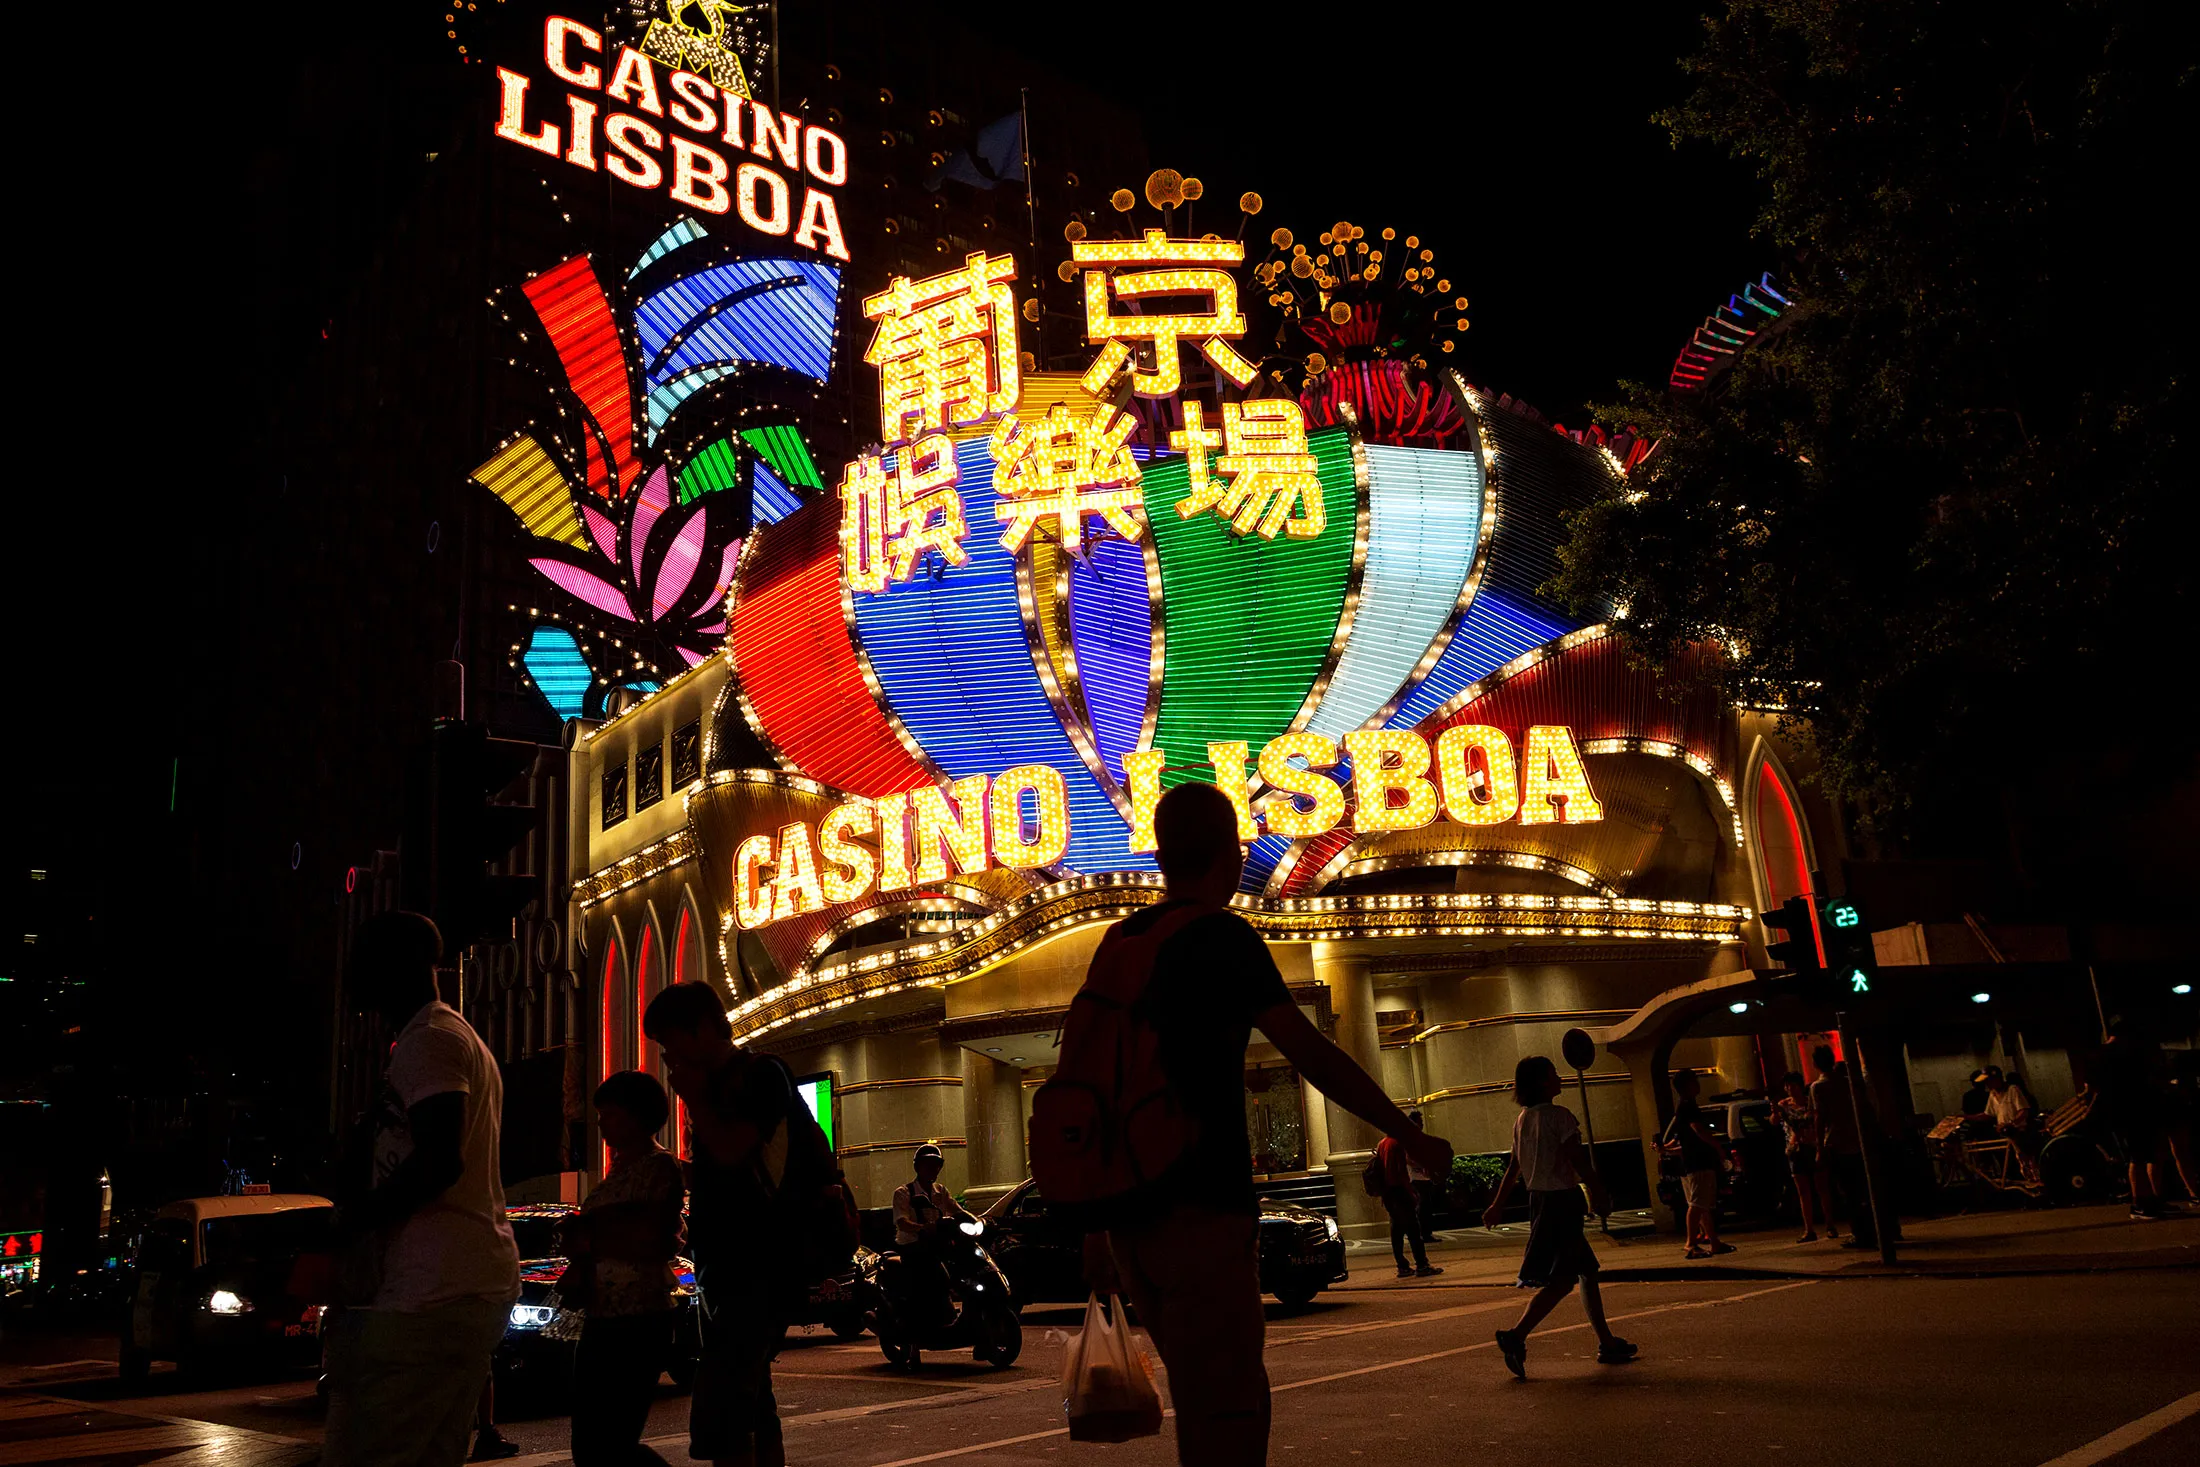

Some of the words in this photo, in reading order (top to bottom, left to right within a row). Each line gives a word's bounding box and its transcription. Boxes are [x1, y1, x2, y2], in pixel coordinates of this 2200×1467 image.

[495, 66, 850, 262] LISBOA
[544, 15, 848, 187] CASINO
[862, 227, 1259, 442] 葡京
[733, 764, 1069, 931] CASINO
